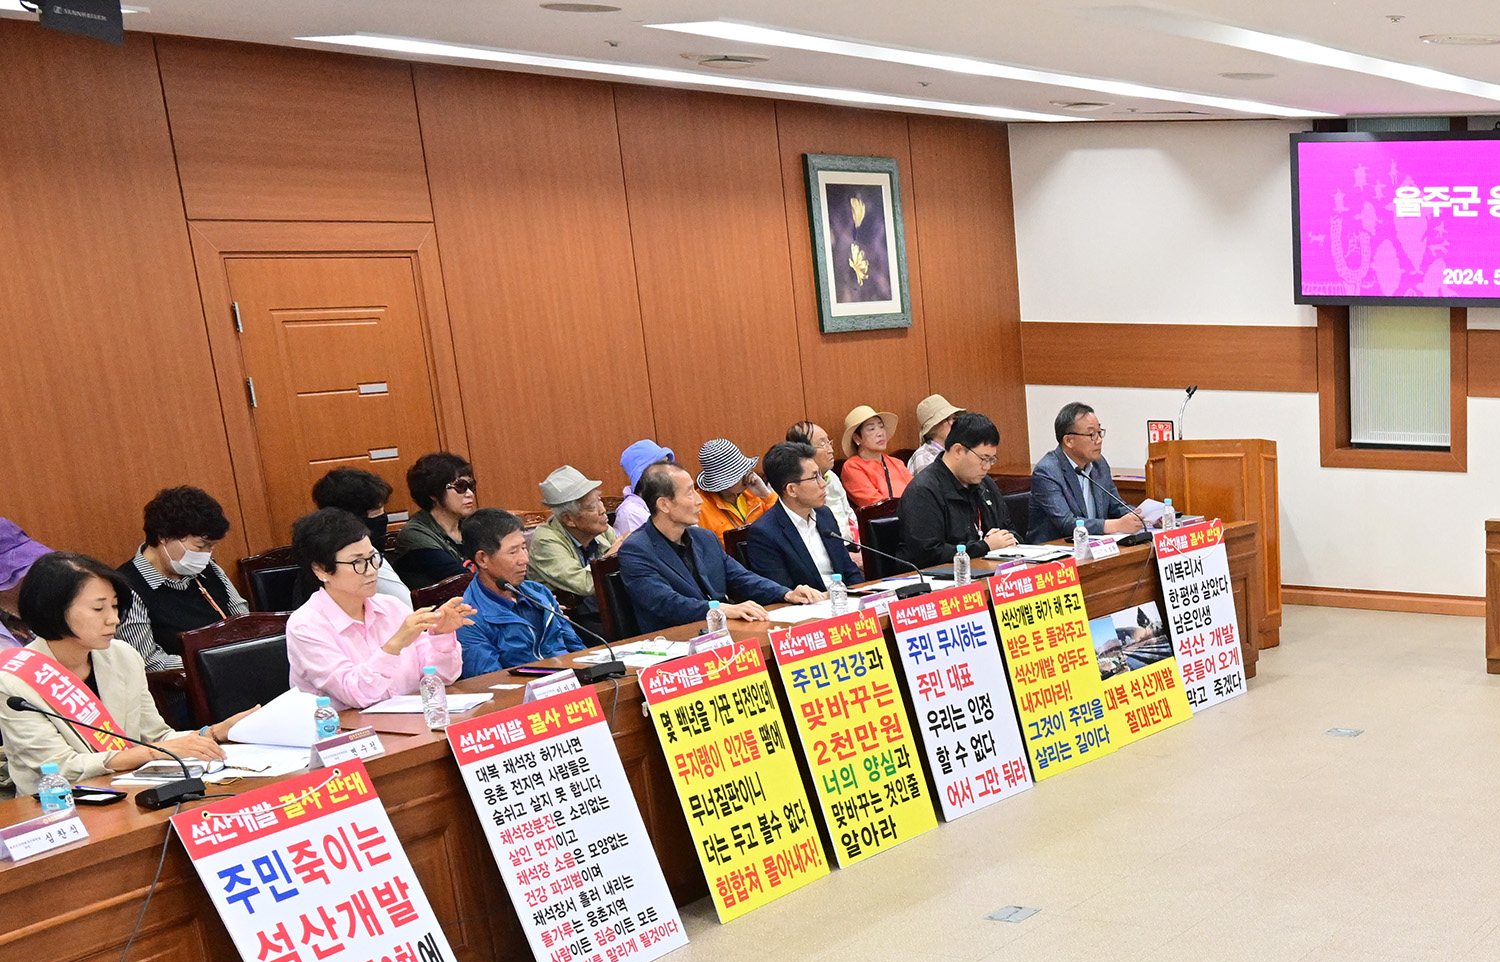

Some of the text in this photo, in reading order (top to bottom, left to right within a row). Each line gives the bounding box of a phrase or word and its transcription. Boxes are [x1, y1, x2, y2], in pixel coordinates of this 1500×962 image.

[1393, 185, 1481, 217] 울주군
[1442, 269, 1488, 286] 2024.
[1159, 526, 1221, 552] 석산개발 결사 반대
[995, 563, 1075, 598] 석산개발 결사 반대
[1164, 555, 1203, 582] 대복리서
[1200, 574, 1228, 600] 살았다
[896, 590, 983, 625] 석산개발 결사 반대
[1001, 593, 1081, 629] 석산개발 허가 해 주고
[779, 616, 877, 656] 석산개발 결사 반대
[906, 621, 986, 664] 주민 무시하는
[1006, 620, 1086, 659] 받은 돈 돌려주고
[1179, 623, 1234, 657] 석산 개발
[649, 648, 760, 694] 석산개발 결사 반대
[791, 646, 883, 693] 주민 건강과
[916, 662, 974, 701] 주민 대표
[1015, 647, 1088, 685] 석산개발 엄두도
[1182, 646, 1239, 683] 못들어 오게
[1213, 671, 1241, 696] 죽겠다
[34, 663, 100, 725] 석산개발
[659, 680, 774, 743] 몇 백년을 가꾼 터전인데
[800, 681, 893, 729] 맞바꾸는
[927, 692, 993, 737] 우리는 인정
[1020, 679, 1072, 712] 내지마라!
[1103, 684, 1129, 710] 대복
[1124, 697, 1172, 733] 절대반대
[460, 696, 597, 753] 석산개발 결사 반대
[813, 713, 903, 765] 2천만원
[1028, 698, 1103, 740] 그것이 주민을
[475, 736, 583, 782] 대복 채석장 허가나면
[674, 720, 785, 784] 무지랭이 인간들 땜에
[936, 730, 996, 774] 할 수 없다
[1035, 724, 1110, 769] 살리는 길이다
[483, 756, 589, 805] 웅촌 전지역 사람들은
[822, 744, 910, 794] 너의 양심과
[946, 756, 1027, 808] 어서 그만 둬라
[191, 771, 367, 844] 석산개발 결사 반대
[492, 774, 601, 825] 숨쉬고 살지 못 합니다
[500, 795, 609, 844] 채석장분진은 소리없는
[689, 772, 765, 825] 무너질판이니
[831, 773, 920, 828] 맞바꾸는 것인줄
[508, 829, 578, 866] 살인 먼지이고
[702, 798, 808, 865] 더는 두고 볼수 없다
[841, 814, 896, 858] 알아라
[218, 823, 390, 912] 주민죽이는
[516, 833, 628, 885] 채석장 소음은 모양없는
[716, 836, 821, 908] 힘합쳐 몰아내자!
[524, 863, 603, 907] 건강 파괴범이며
[533, 875, 633, 925] 채석장서 흘러 내리는
[540, 897, 627, 947] 돌가루는 웅촌지역
[594, 917, 635, 946] 짐승이든
[637, 906, 657, 926] 모든
[605, 937, 638, 962] 말리게
[639, 918, 678, 947] 될것이다
